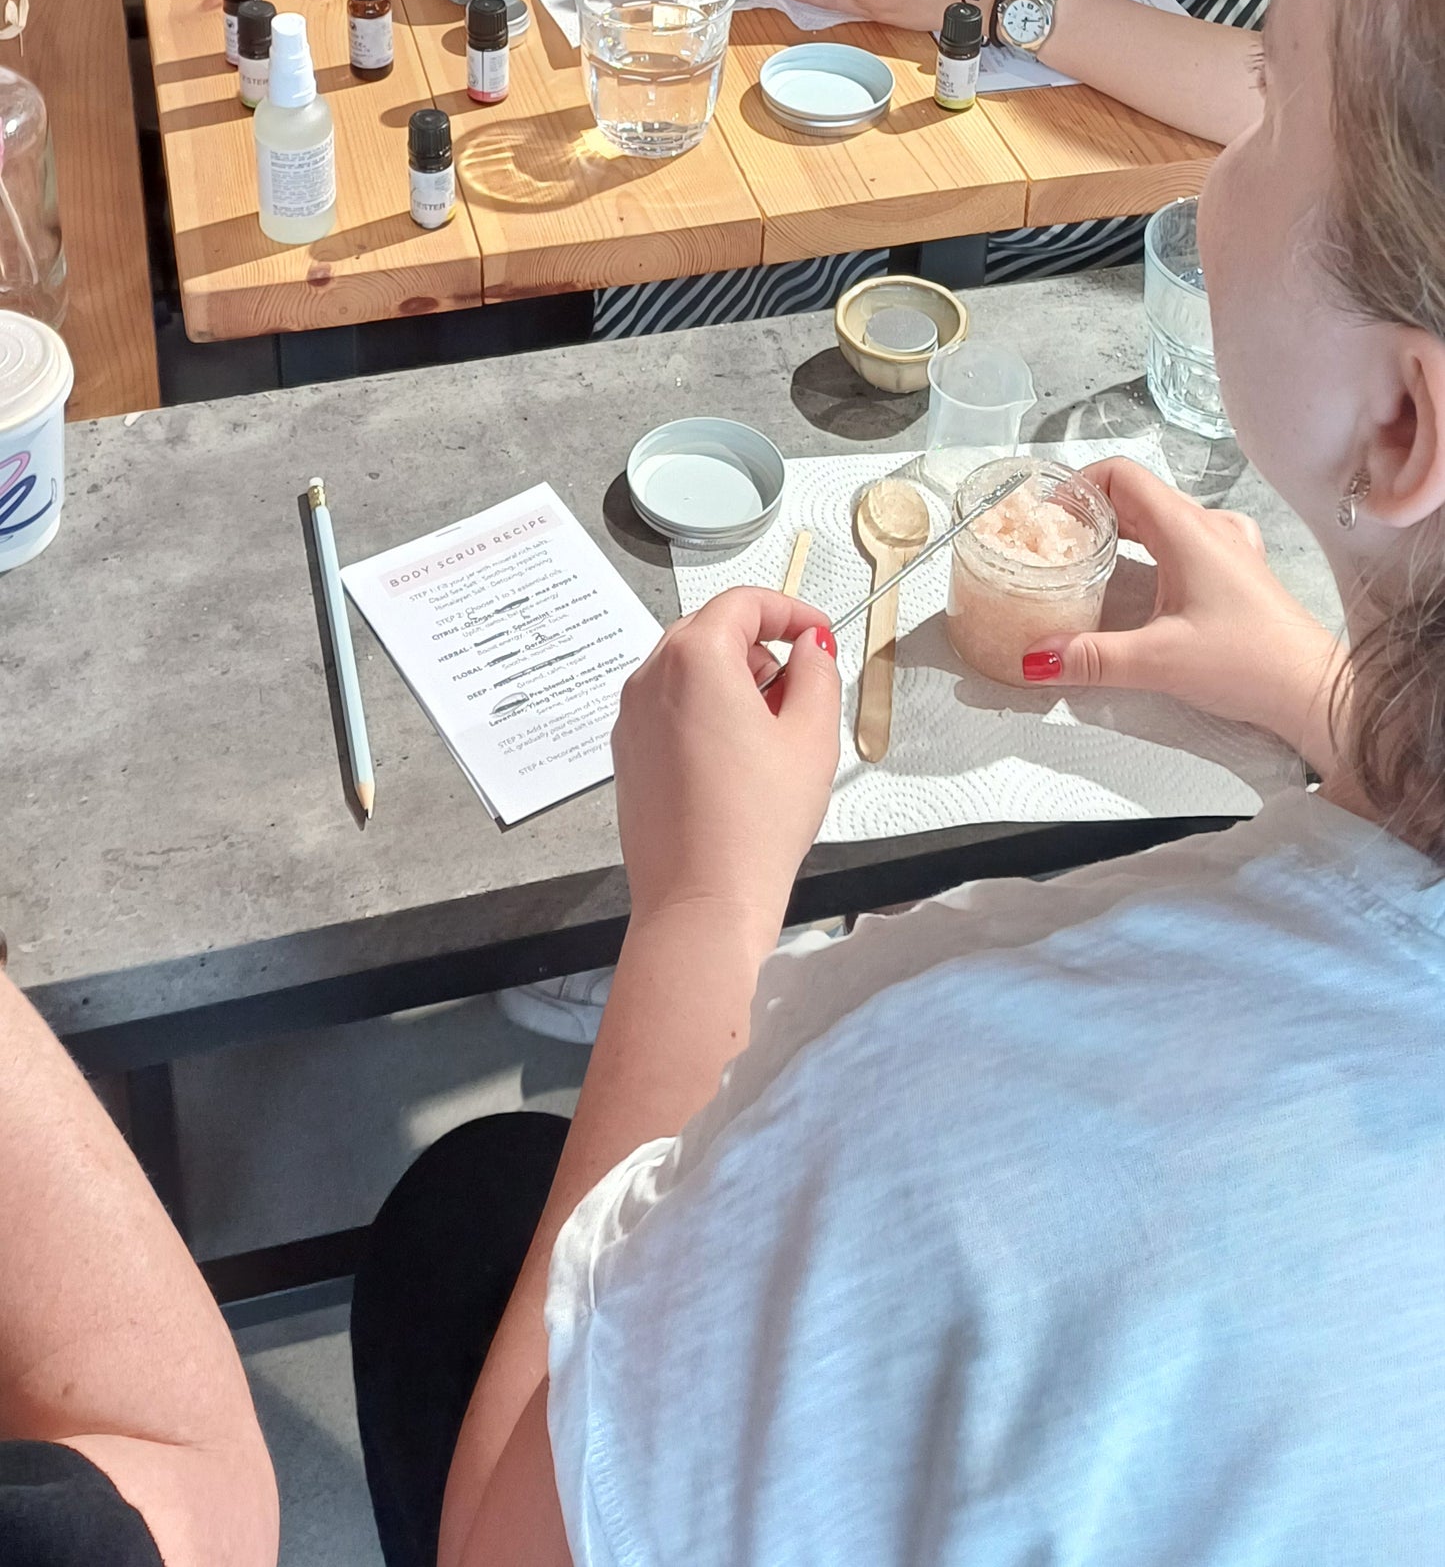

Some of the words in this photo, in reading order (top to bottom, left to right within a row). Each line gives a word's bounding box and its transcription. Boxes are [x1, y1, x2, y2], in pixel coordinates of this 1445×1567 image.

[241, 74, 269, 85] ESTER
[389, 565, 430, 588] BODY
[437, 543, 487, 569] SCRUB
[493, 515, 547, 544] RECIPE
[409, 591, 428, 602] STEP
[428, 592, 449, 604] Dead
[449, 587, 463, 595] Sea
[463, 580, 478, 588] Salt
[516, 549, 548, 566] repairing
[434, 593, 472, 611] Himalayan
[471, 586, 486, 596] Salt
[435, 614, 455, 626] STEP
[465, 599, 494, 614] Choose
[517, 573, 548, 592] essential
[431, 626, 459, 641] CITRUS
[535, 587, 550, 596] max
[551, 577, 572, 589] drops
[437, 647, 470, 663] HERBAL
[512, 611, 550, 631] Spearmint
[554, 602, 569, 611] max
[571, 593, 592, 604] drops
[452, 666, 483, 682] FLORAL
[524, 632, 561, 651] Geranium
[565, 622, 580, 632] max
[581, 613, 603, 625] drops
[466, 688, 487, 701] DEEP
[596, 631, 617, 644] drops
[529, 674, 575, 698] Pre-blended
[580, 666, 596, 676] max
[597, 656, 618, 669] drops
[497, 736, 516, 749] STEP
[526, 723, 542, 735] Add
[548, 707, 583, 724] maximum
[583, 701, 591, 710] of
[602, 689, 620, 702] drop
[528, 697, 551, 710] Ylang
[515, 731, 549, 751] gradually
[550, 723, 567, 735] pour
[566, 716, 580, 726] this
[580, 709, 596, 720] over
[597, 704, 609, 712] the
[552, 734, 561, 743] all
[561, 729, 573, 737] the
[574, 722, 587, 732] salt
[518, 763, 537, 776] STEP
[546, 745, 580, 763] Decorate
[580, 737, 595, 748] and
[568, 751, 582, 763] and
[583, 743, 602, 755] enjoy
